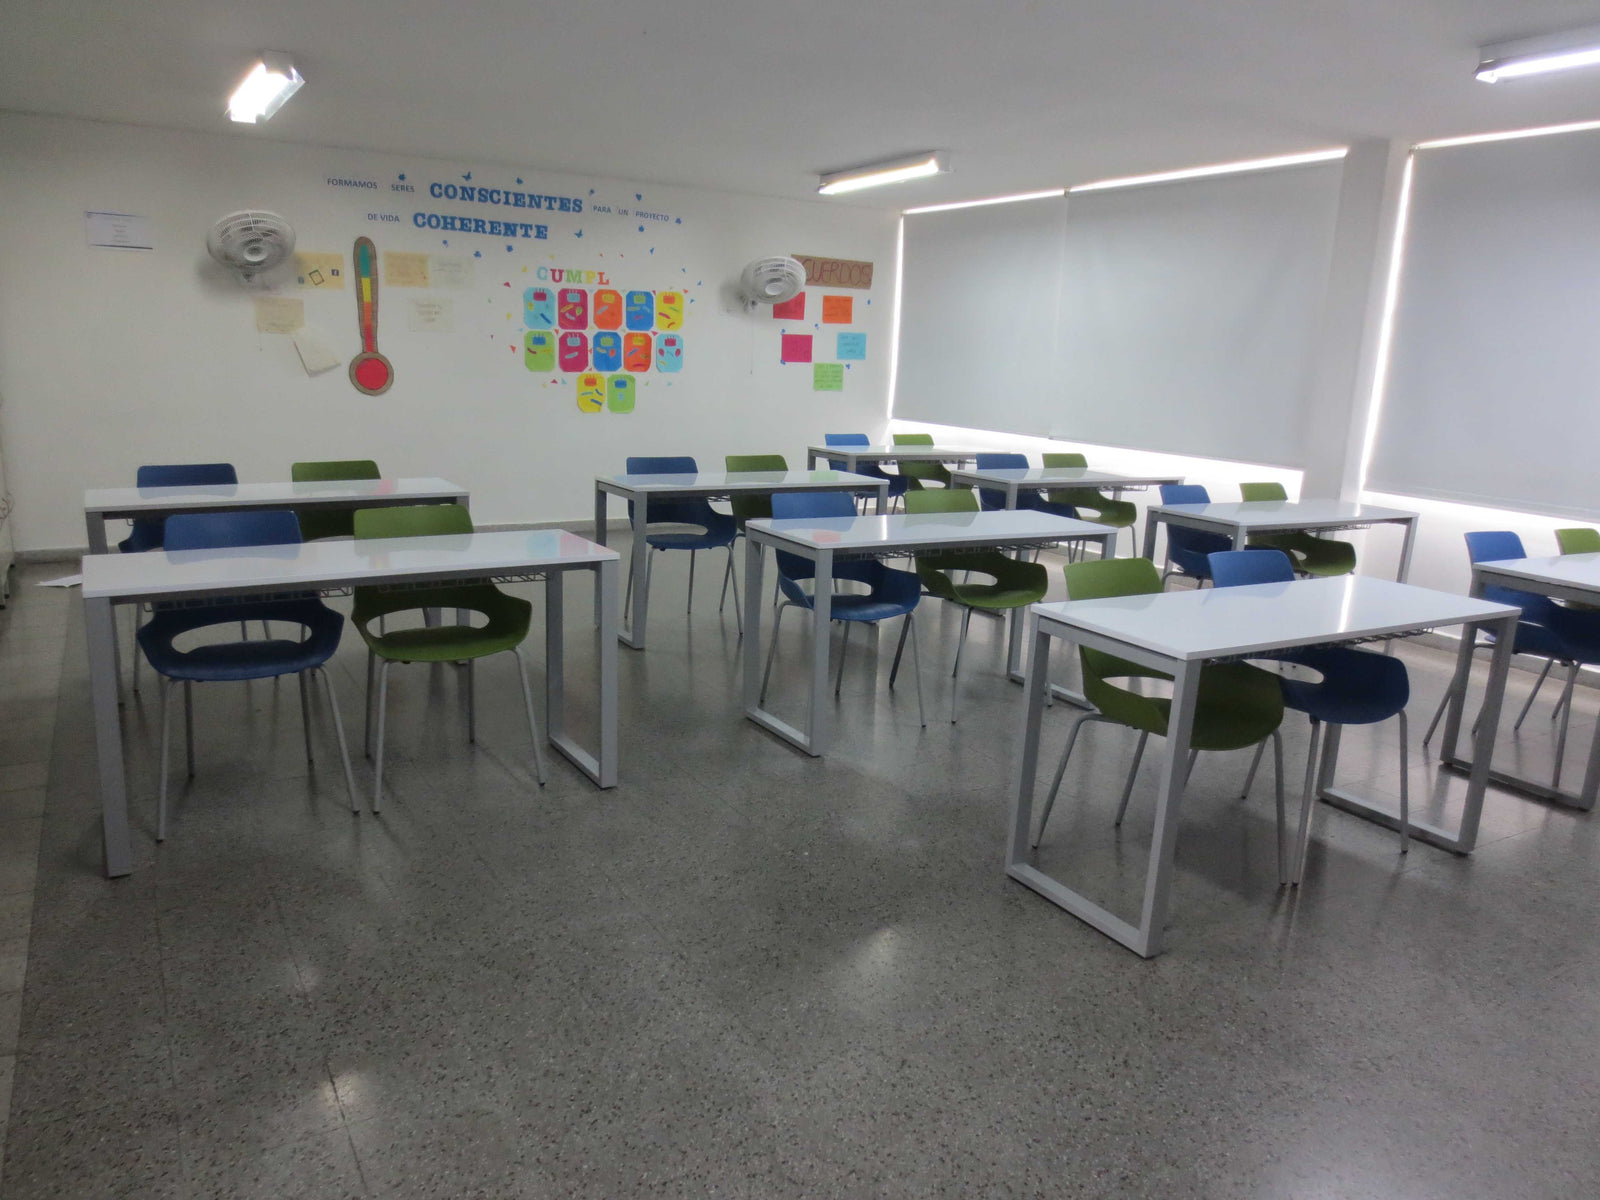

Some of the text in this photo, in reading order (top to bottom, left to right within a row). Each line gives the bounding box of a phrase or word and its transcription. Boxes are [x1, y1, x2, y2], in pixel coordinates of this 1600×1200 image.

[327, 178, 670, 222] FORMAMOS SERES CONSCIENTES PARA UN PROYECTO
[368, 212, 549, 240] DE VIDA COHERENTE
[537, 267, 611, 286] CUMPL
[801, 258, 872, 287] CUERDOS
